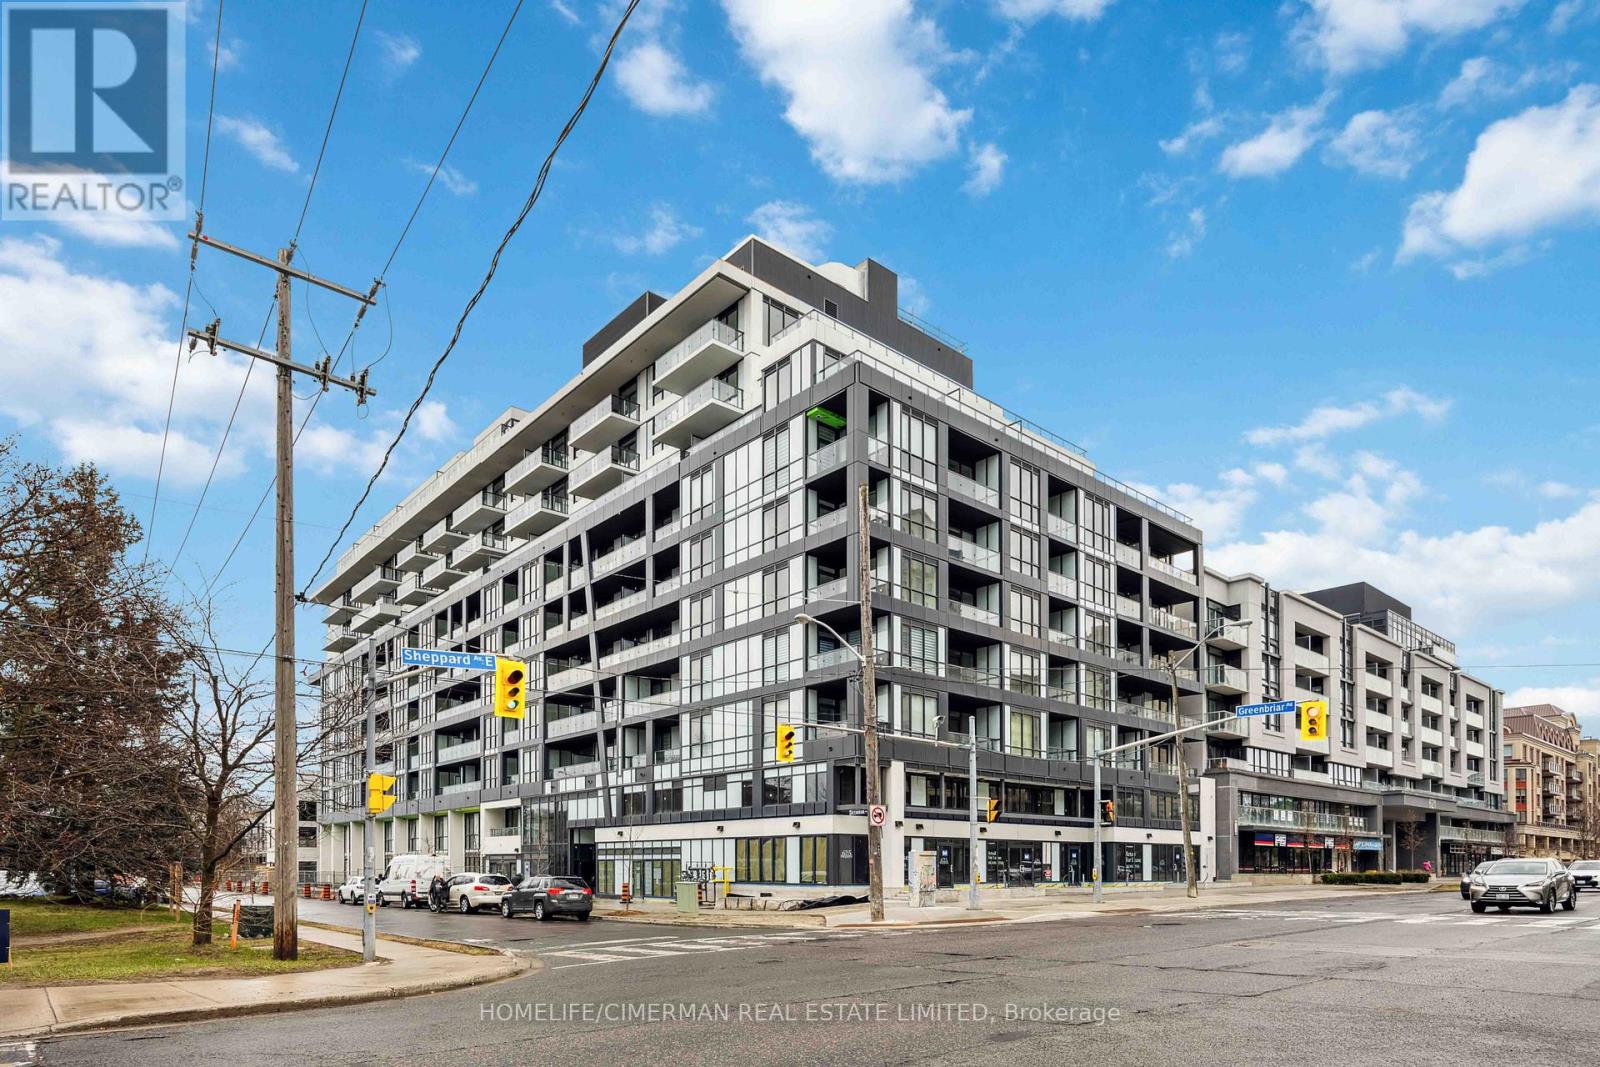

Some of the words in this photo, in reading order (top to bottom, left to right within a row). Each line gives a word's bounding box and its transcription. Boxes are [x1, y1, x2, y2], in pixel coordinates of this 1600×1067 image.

[404, 649, 471, 665] Sheppard
[485, 656, 494, 667] E
[1238, 703, 1285, 715] Greenbriar
